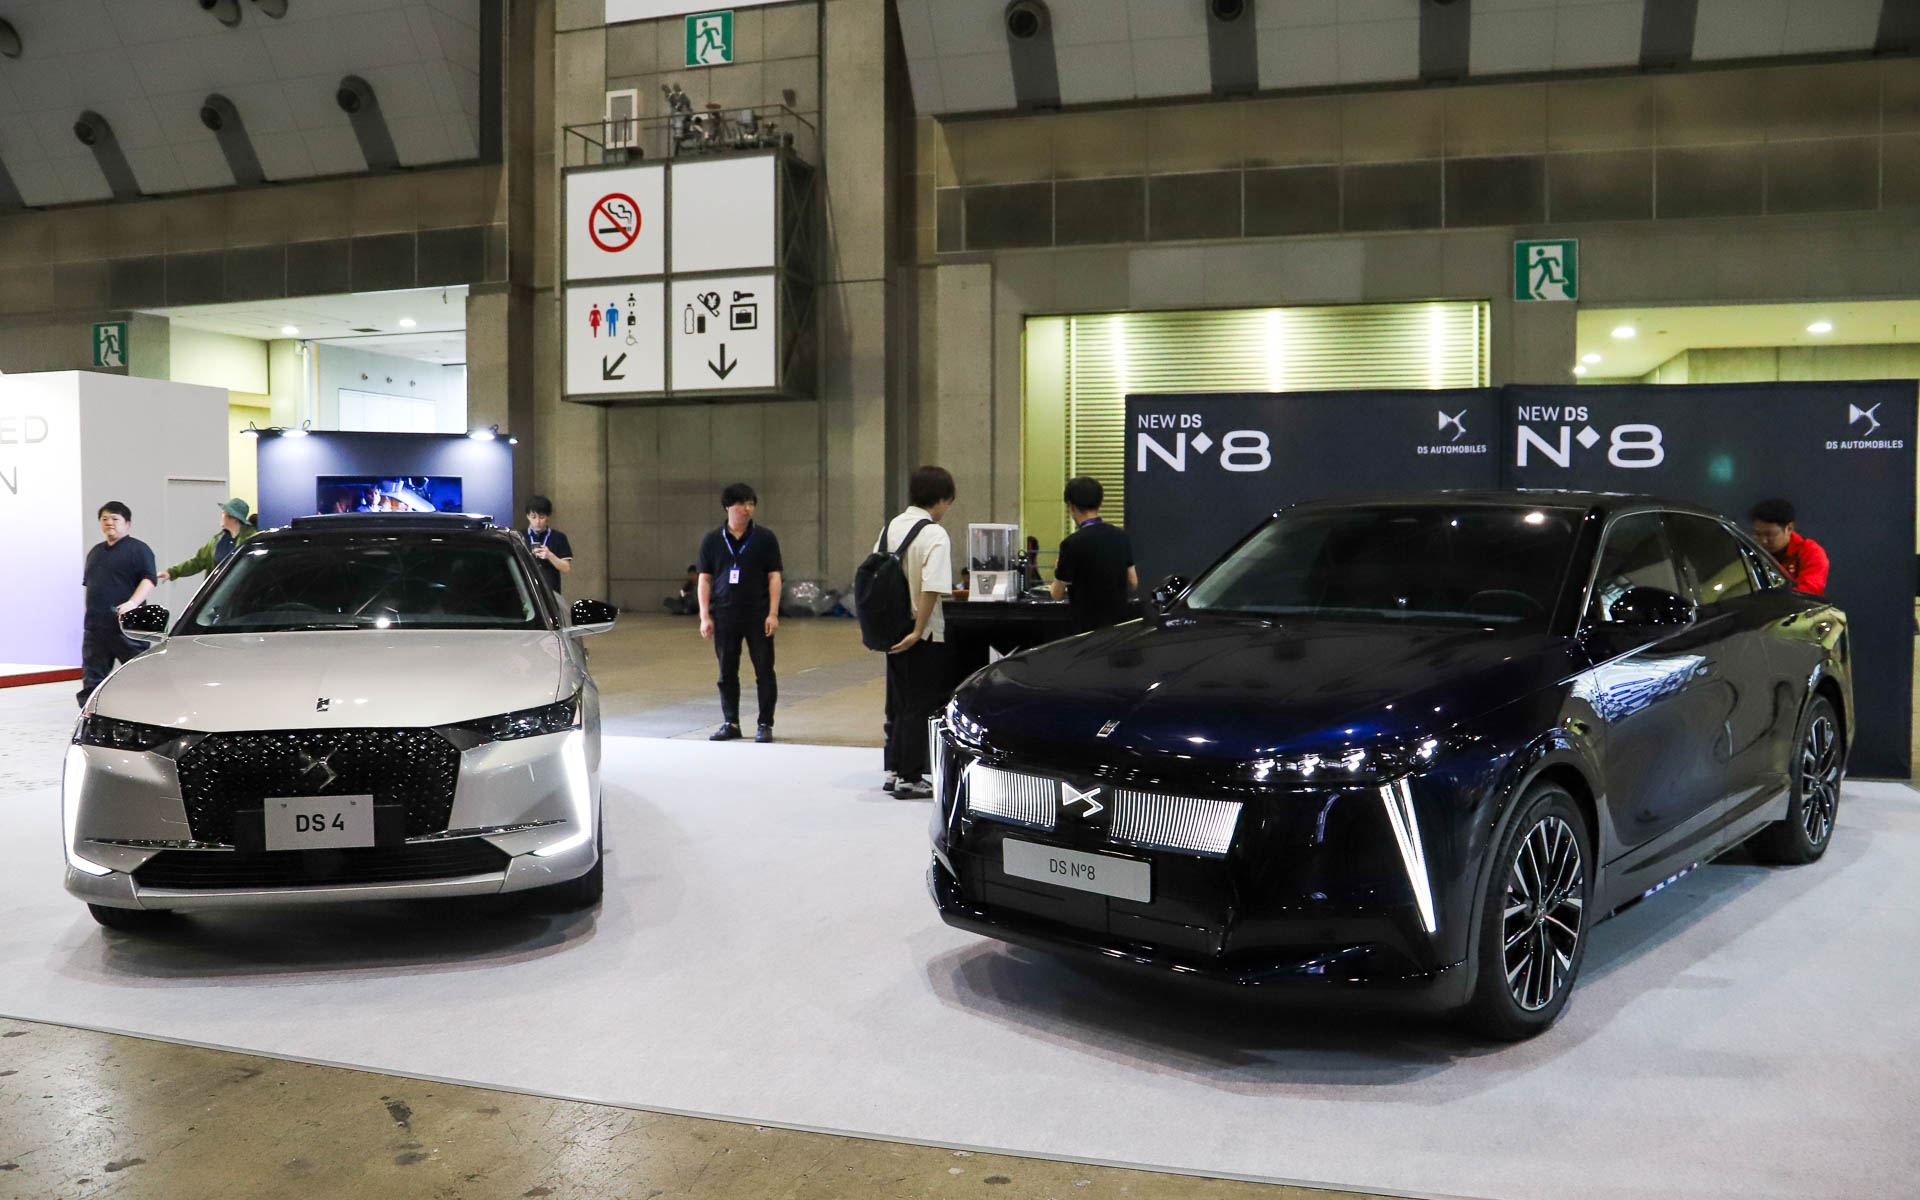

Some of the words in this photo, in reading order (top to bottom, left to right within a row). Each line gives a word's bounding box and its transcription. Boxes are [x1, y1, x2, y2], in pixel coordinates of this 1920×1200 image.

[1517, 406, 1560, 421] NEW
[1564, 406, 1589, 421] DS
[1138, 414, 1176, 428] NEW
[1180, 414, 1202, 428] DS
[1417, 446, 1428, 454] DS
[1431, 445, 1487, 454] AUTOMOBILES
[1826, 441, 1838, 449] DS
[1841, 440, 1904, 449] AUTOMOBILES
[296, 813, 326, 833] DS
[332, 813, 344, 831] 4
[1049, 858, 1067, 875] DS
